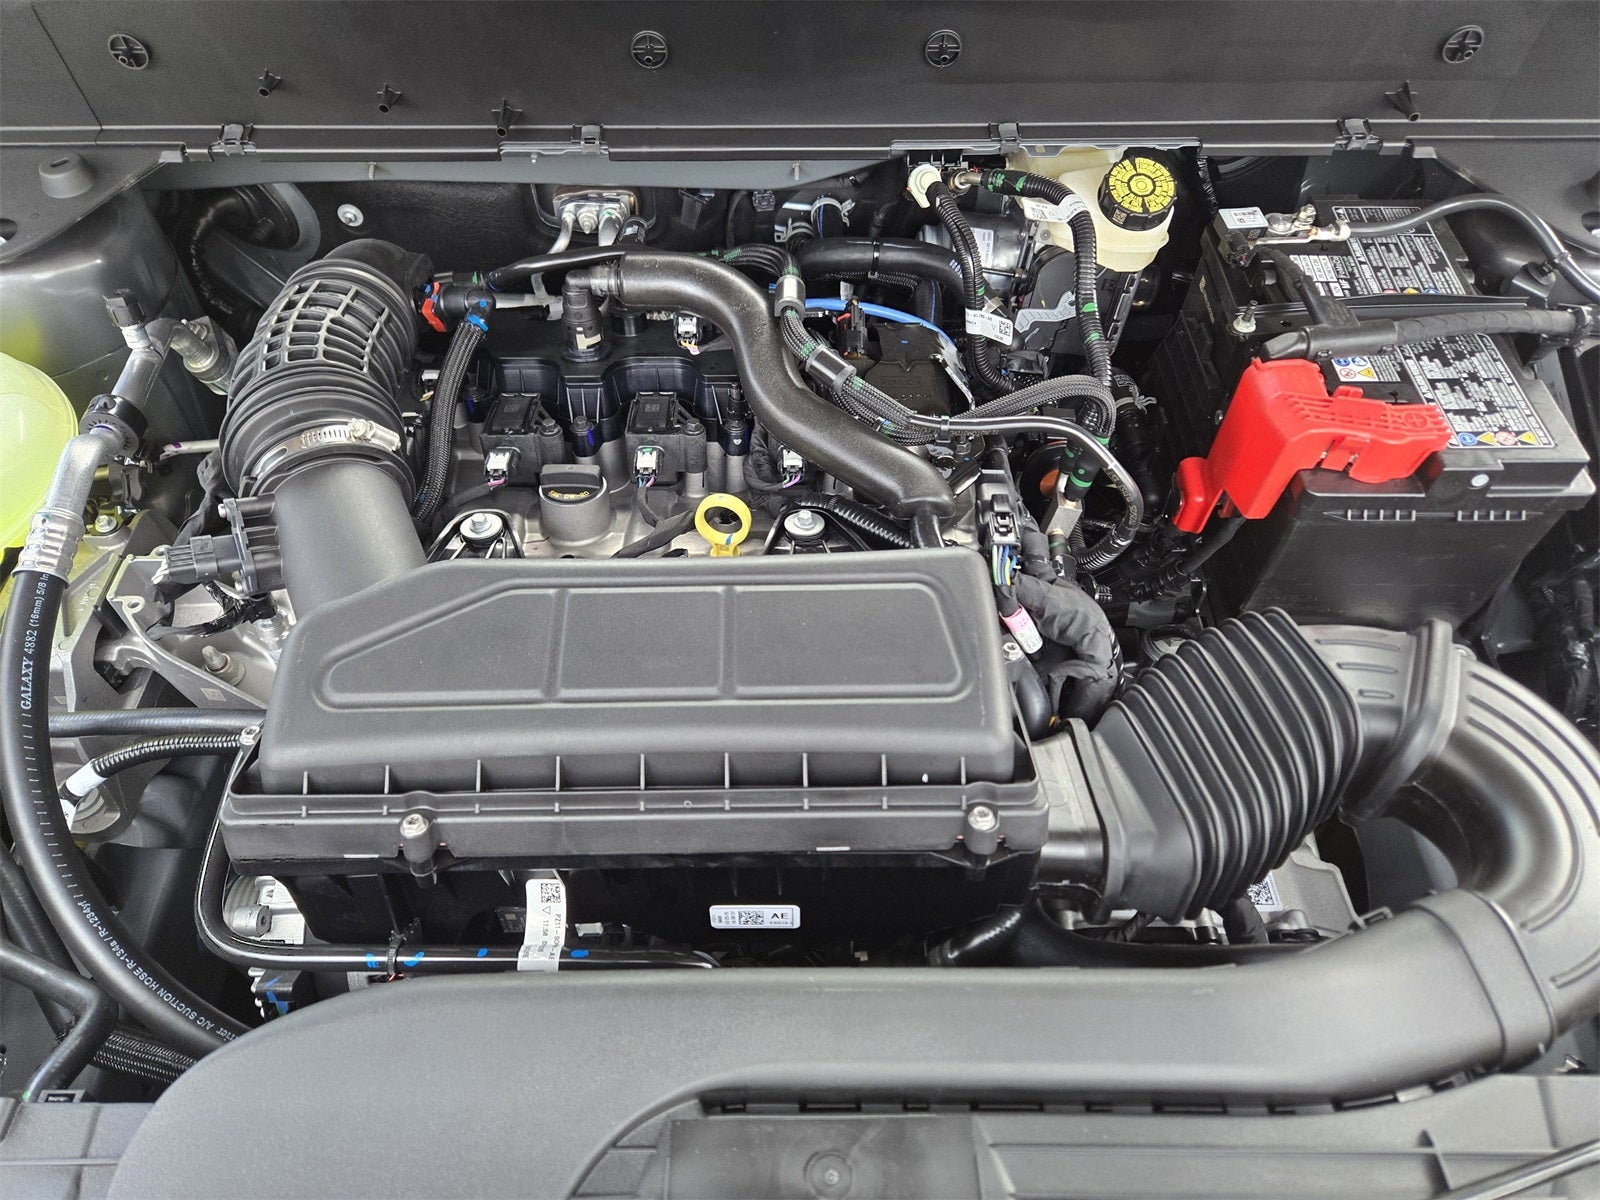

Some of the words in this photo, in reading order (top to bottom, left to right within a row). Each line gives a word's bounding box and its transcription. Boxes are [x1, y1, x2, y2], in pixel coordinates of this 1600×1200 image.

[36, 581, 47, 595] 5/8
[29, 596, 45, 627] (16mm)
[24, 630, 38, 655] 4882
[21, 656, 34, 710] GALAXY
[77, 900, 109, 937] R-1234yf
[109, 940, 137, 969] R-134a
[133, 967, 160, 990] HOSE
[157, 988, 197, 1020] SUCTION
[196, 1016, 215, 1030] A/C
